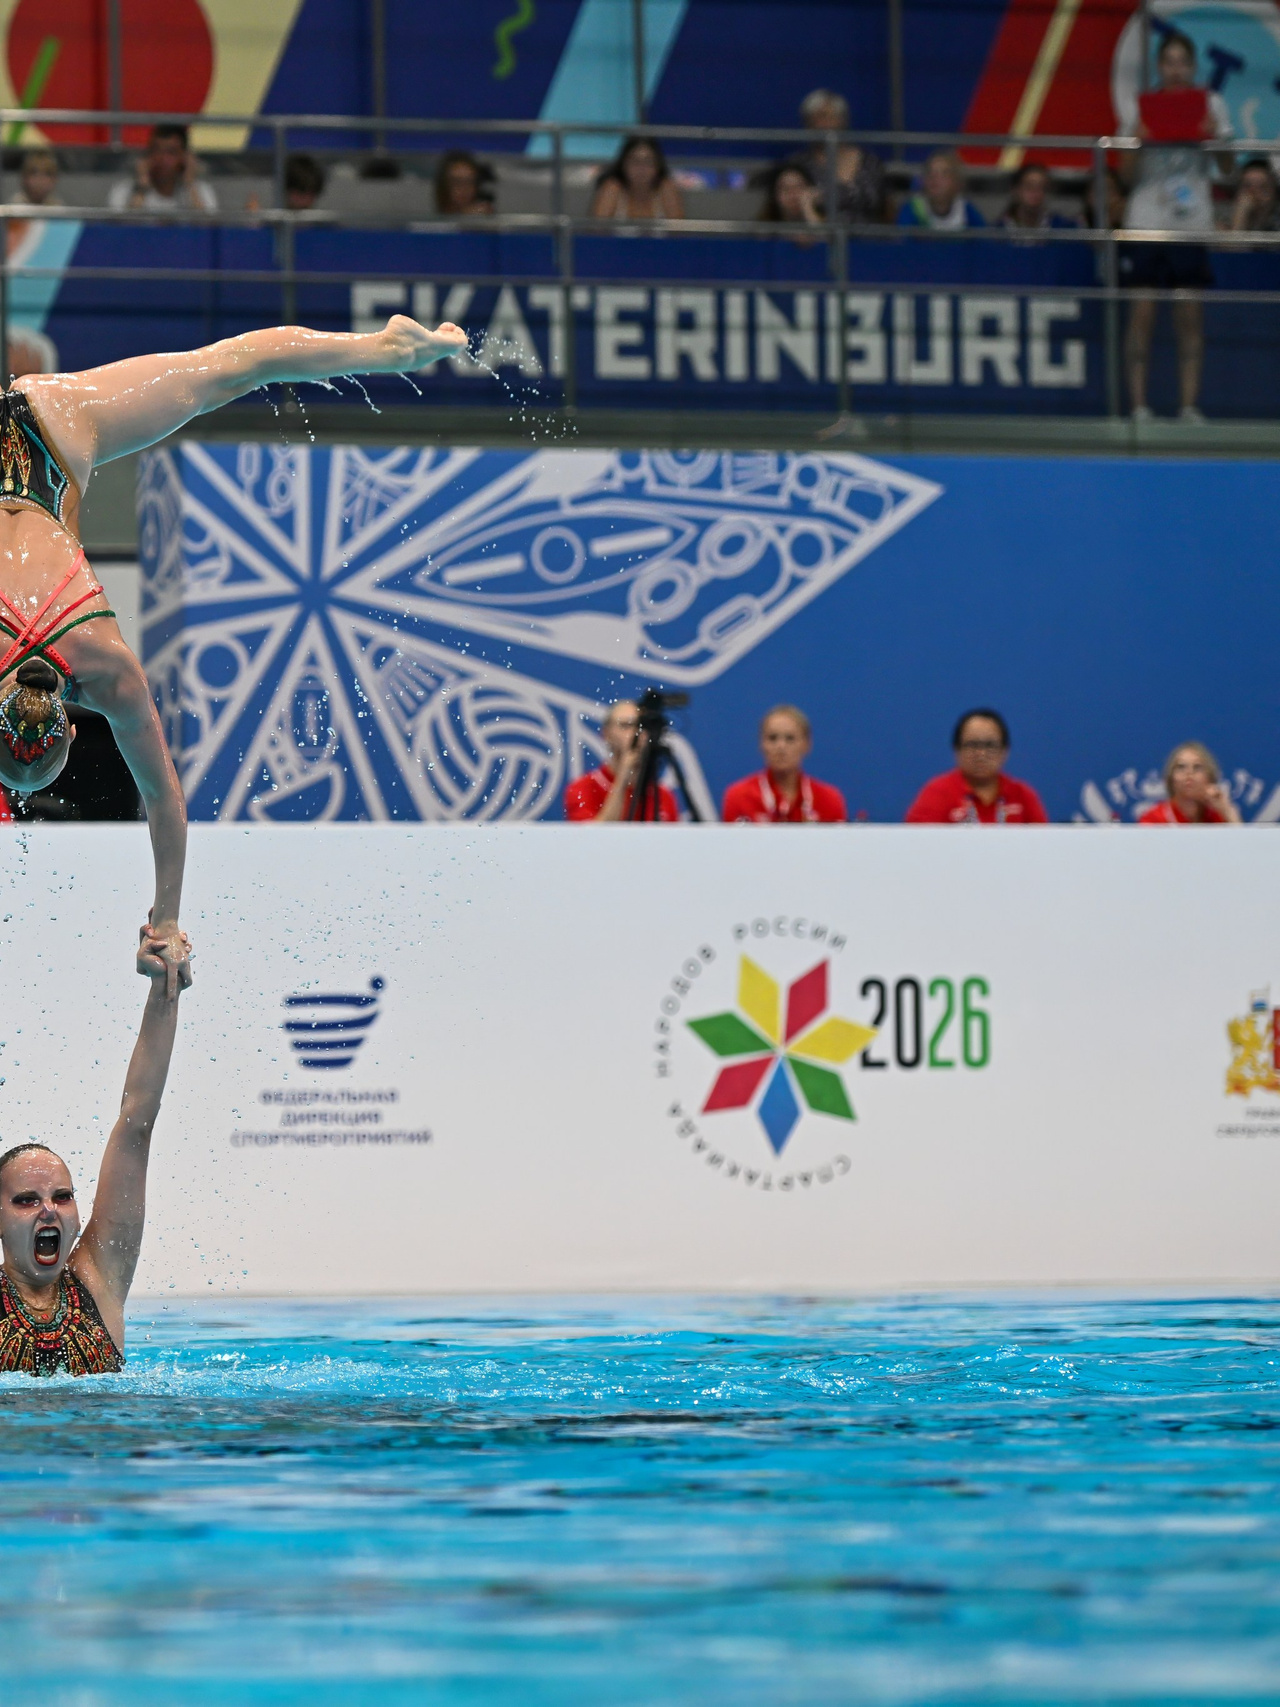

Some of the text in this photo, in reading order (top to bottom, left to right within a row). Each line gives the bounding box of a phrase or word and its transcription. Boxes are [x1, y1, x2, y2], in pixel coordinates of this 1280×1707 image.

[654, 944, 716, 1078] НАРОДОВ
[732, 916, 846, 951] РОССИИ
[859, 974, 991, 1070] 2026
